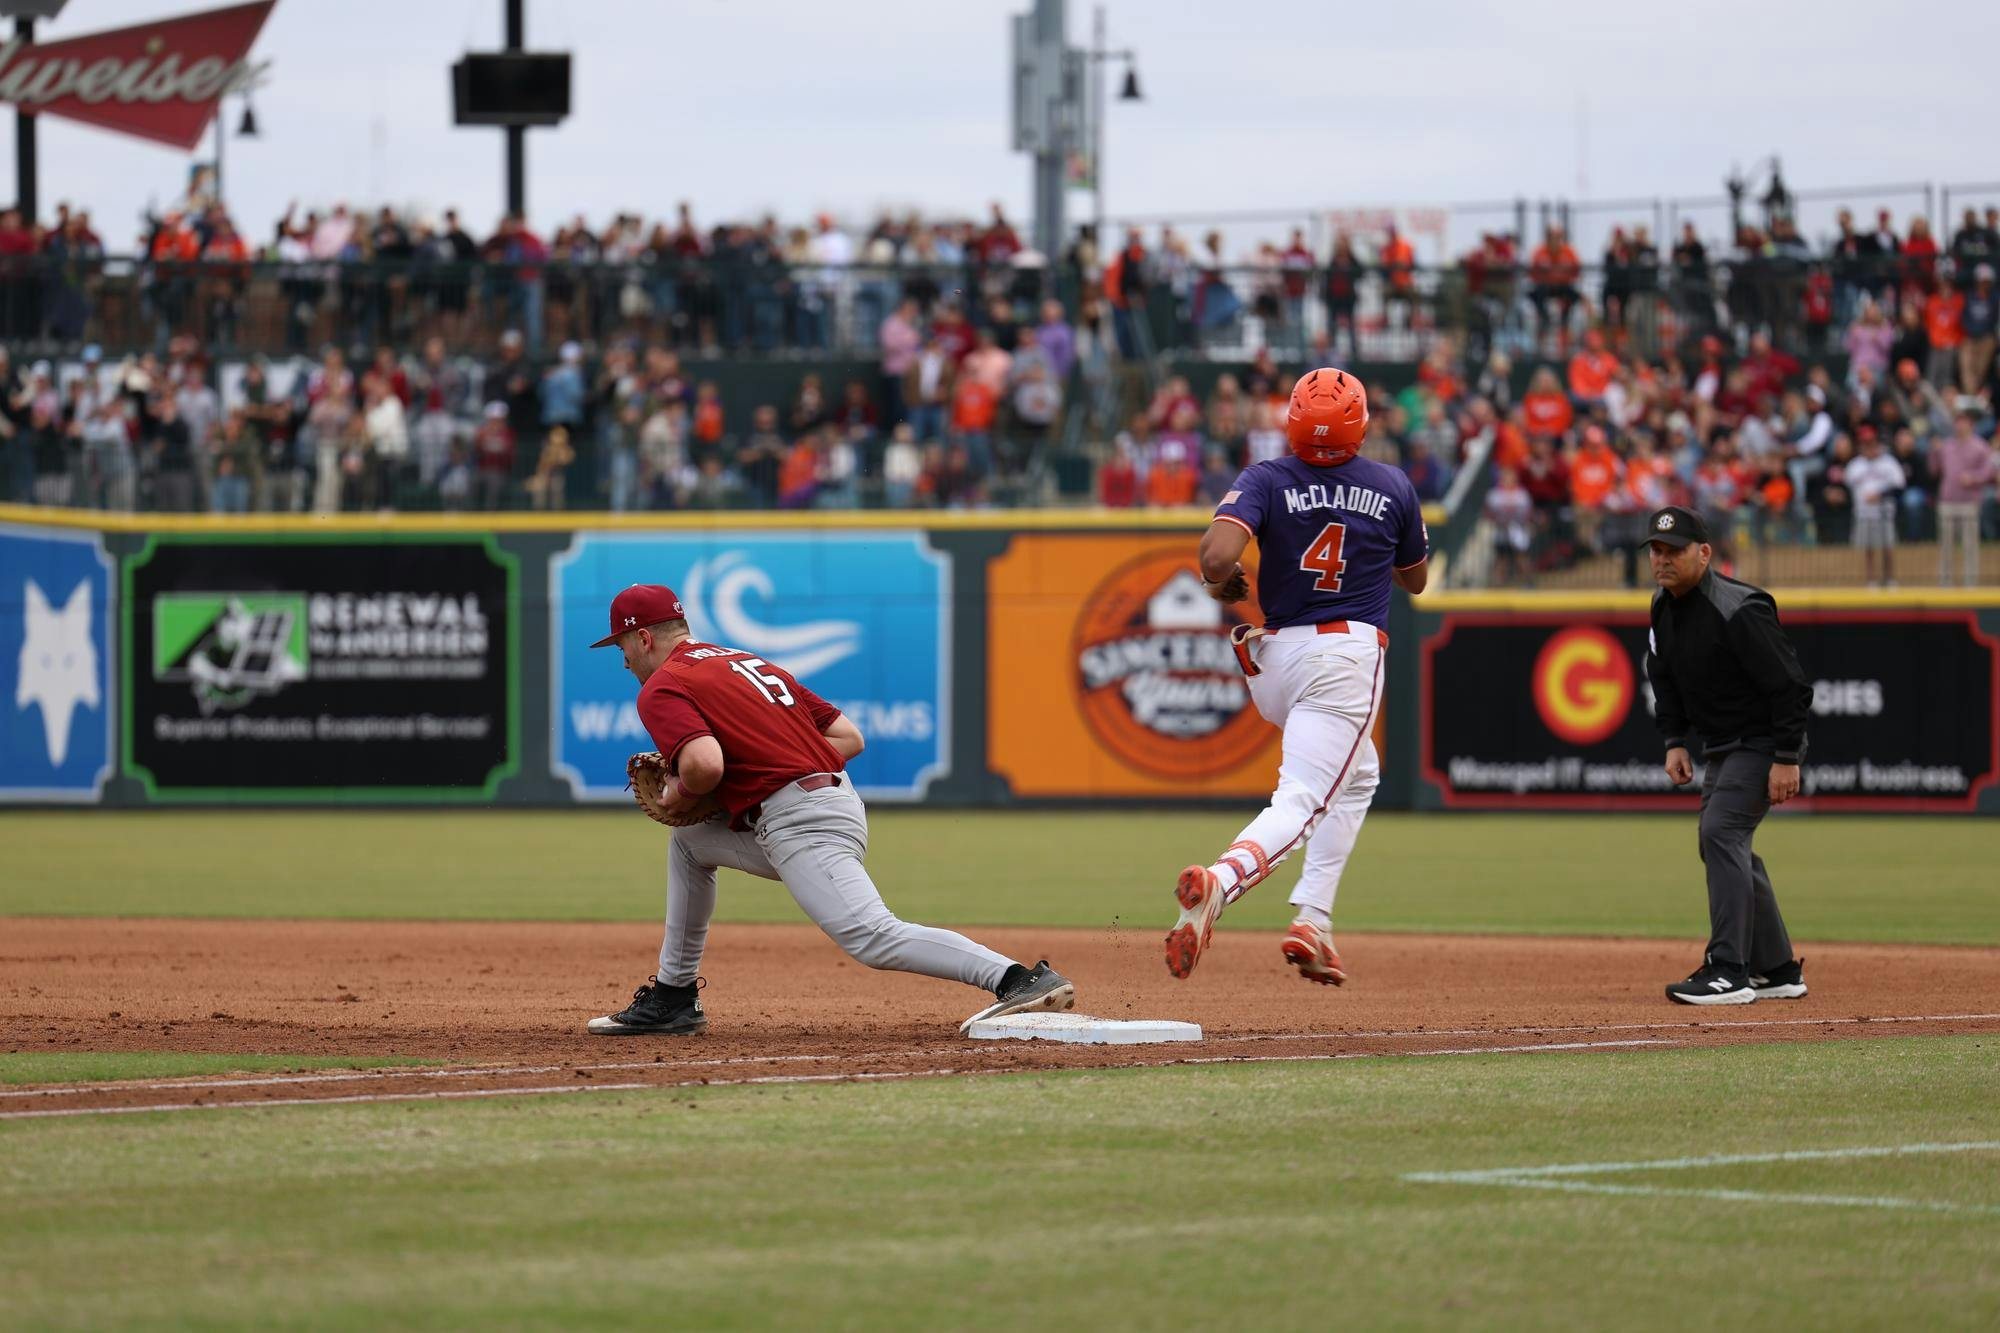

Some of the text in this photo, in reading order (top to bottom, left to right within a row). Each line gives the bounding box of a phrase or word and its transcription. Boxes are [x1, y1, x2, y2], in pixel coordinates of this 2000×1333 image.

[0, 36, 272, 103] weiser
[1284, 484, 1392, 521] McCLADDIE
[1300, 522, 1347, 593] 4
[727, 658, 796, 708] 15
[1546, 637, 1621, 731] G
